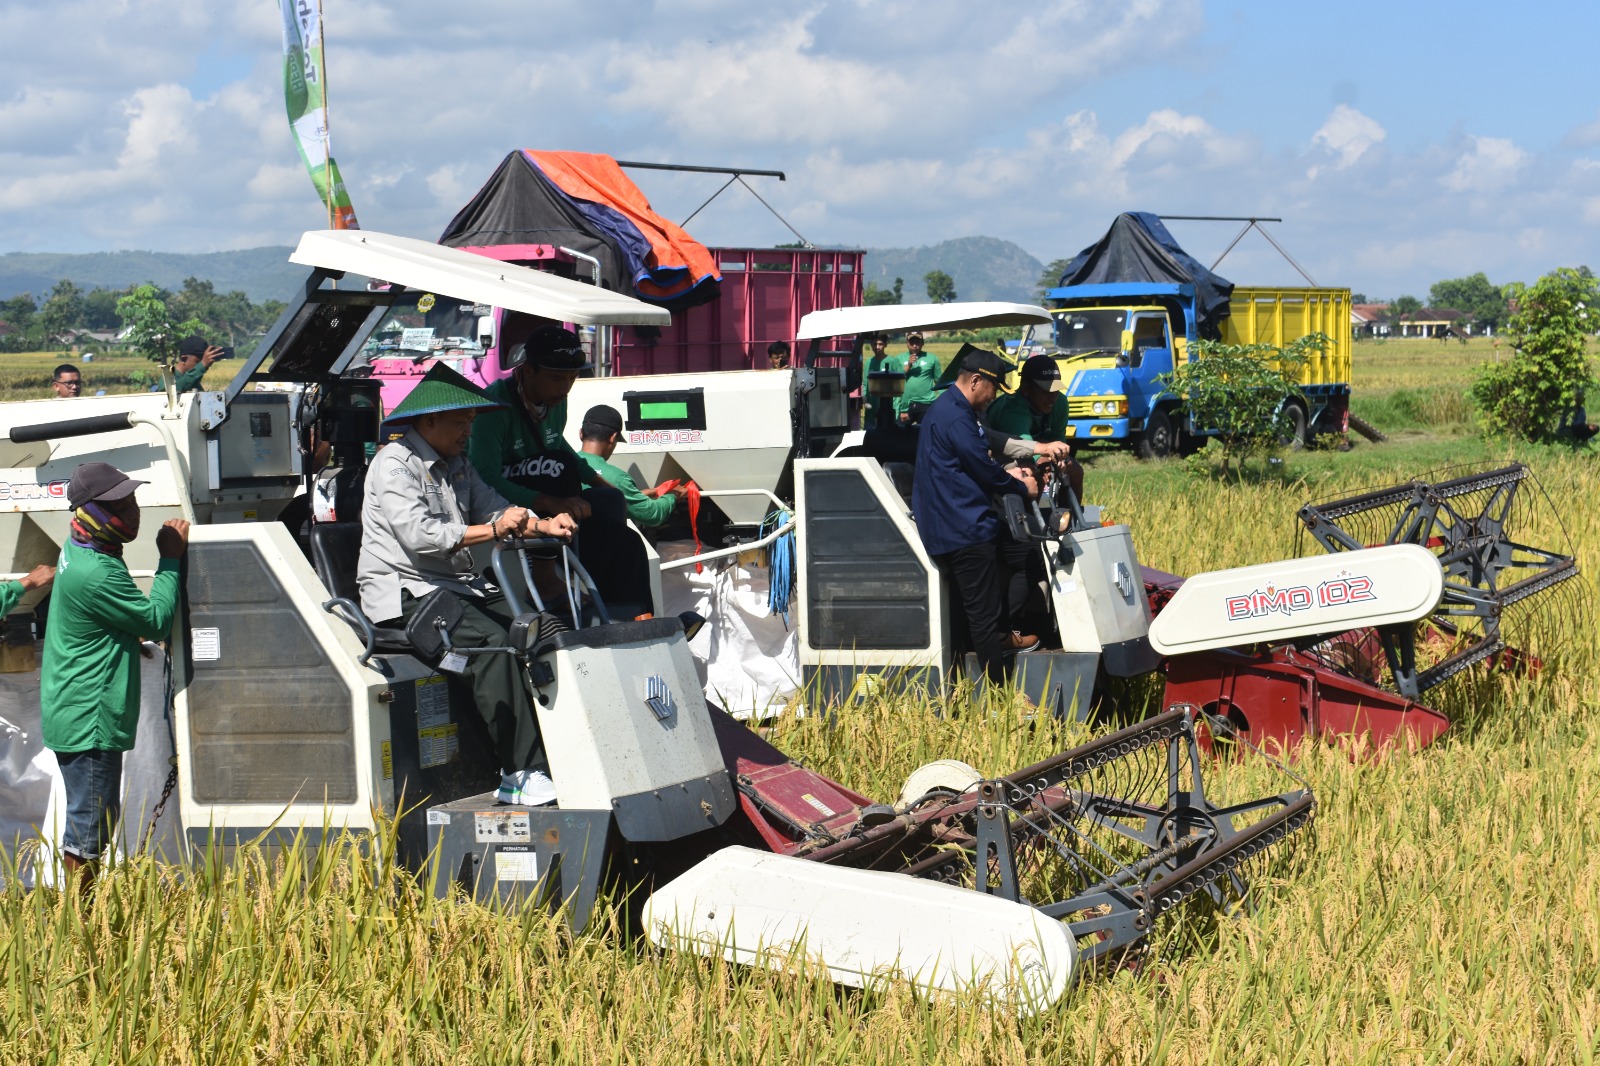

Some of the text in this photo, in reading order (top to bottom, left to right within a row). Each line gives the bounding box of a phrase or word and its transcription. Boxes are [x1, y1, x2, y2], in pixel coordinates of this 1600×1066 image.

[629, 429, 703, 446] BIMO 102
[1226, 576, 1377, 621] BIMO 102
